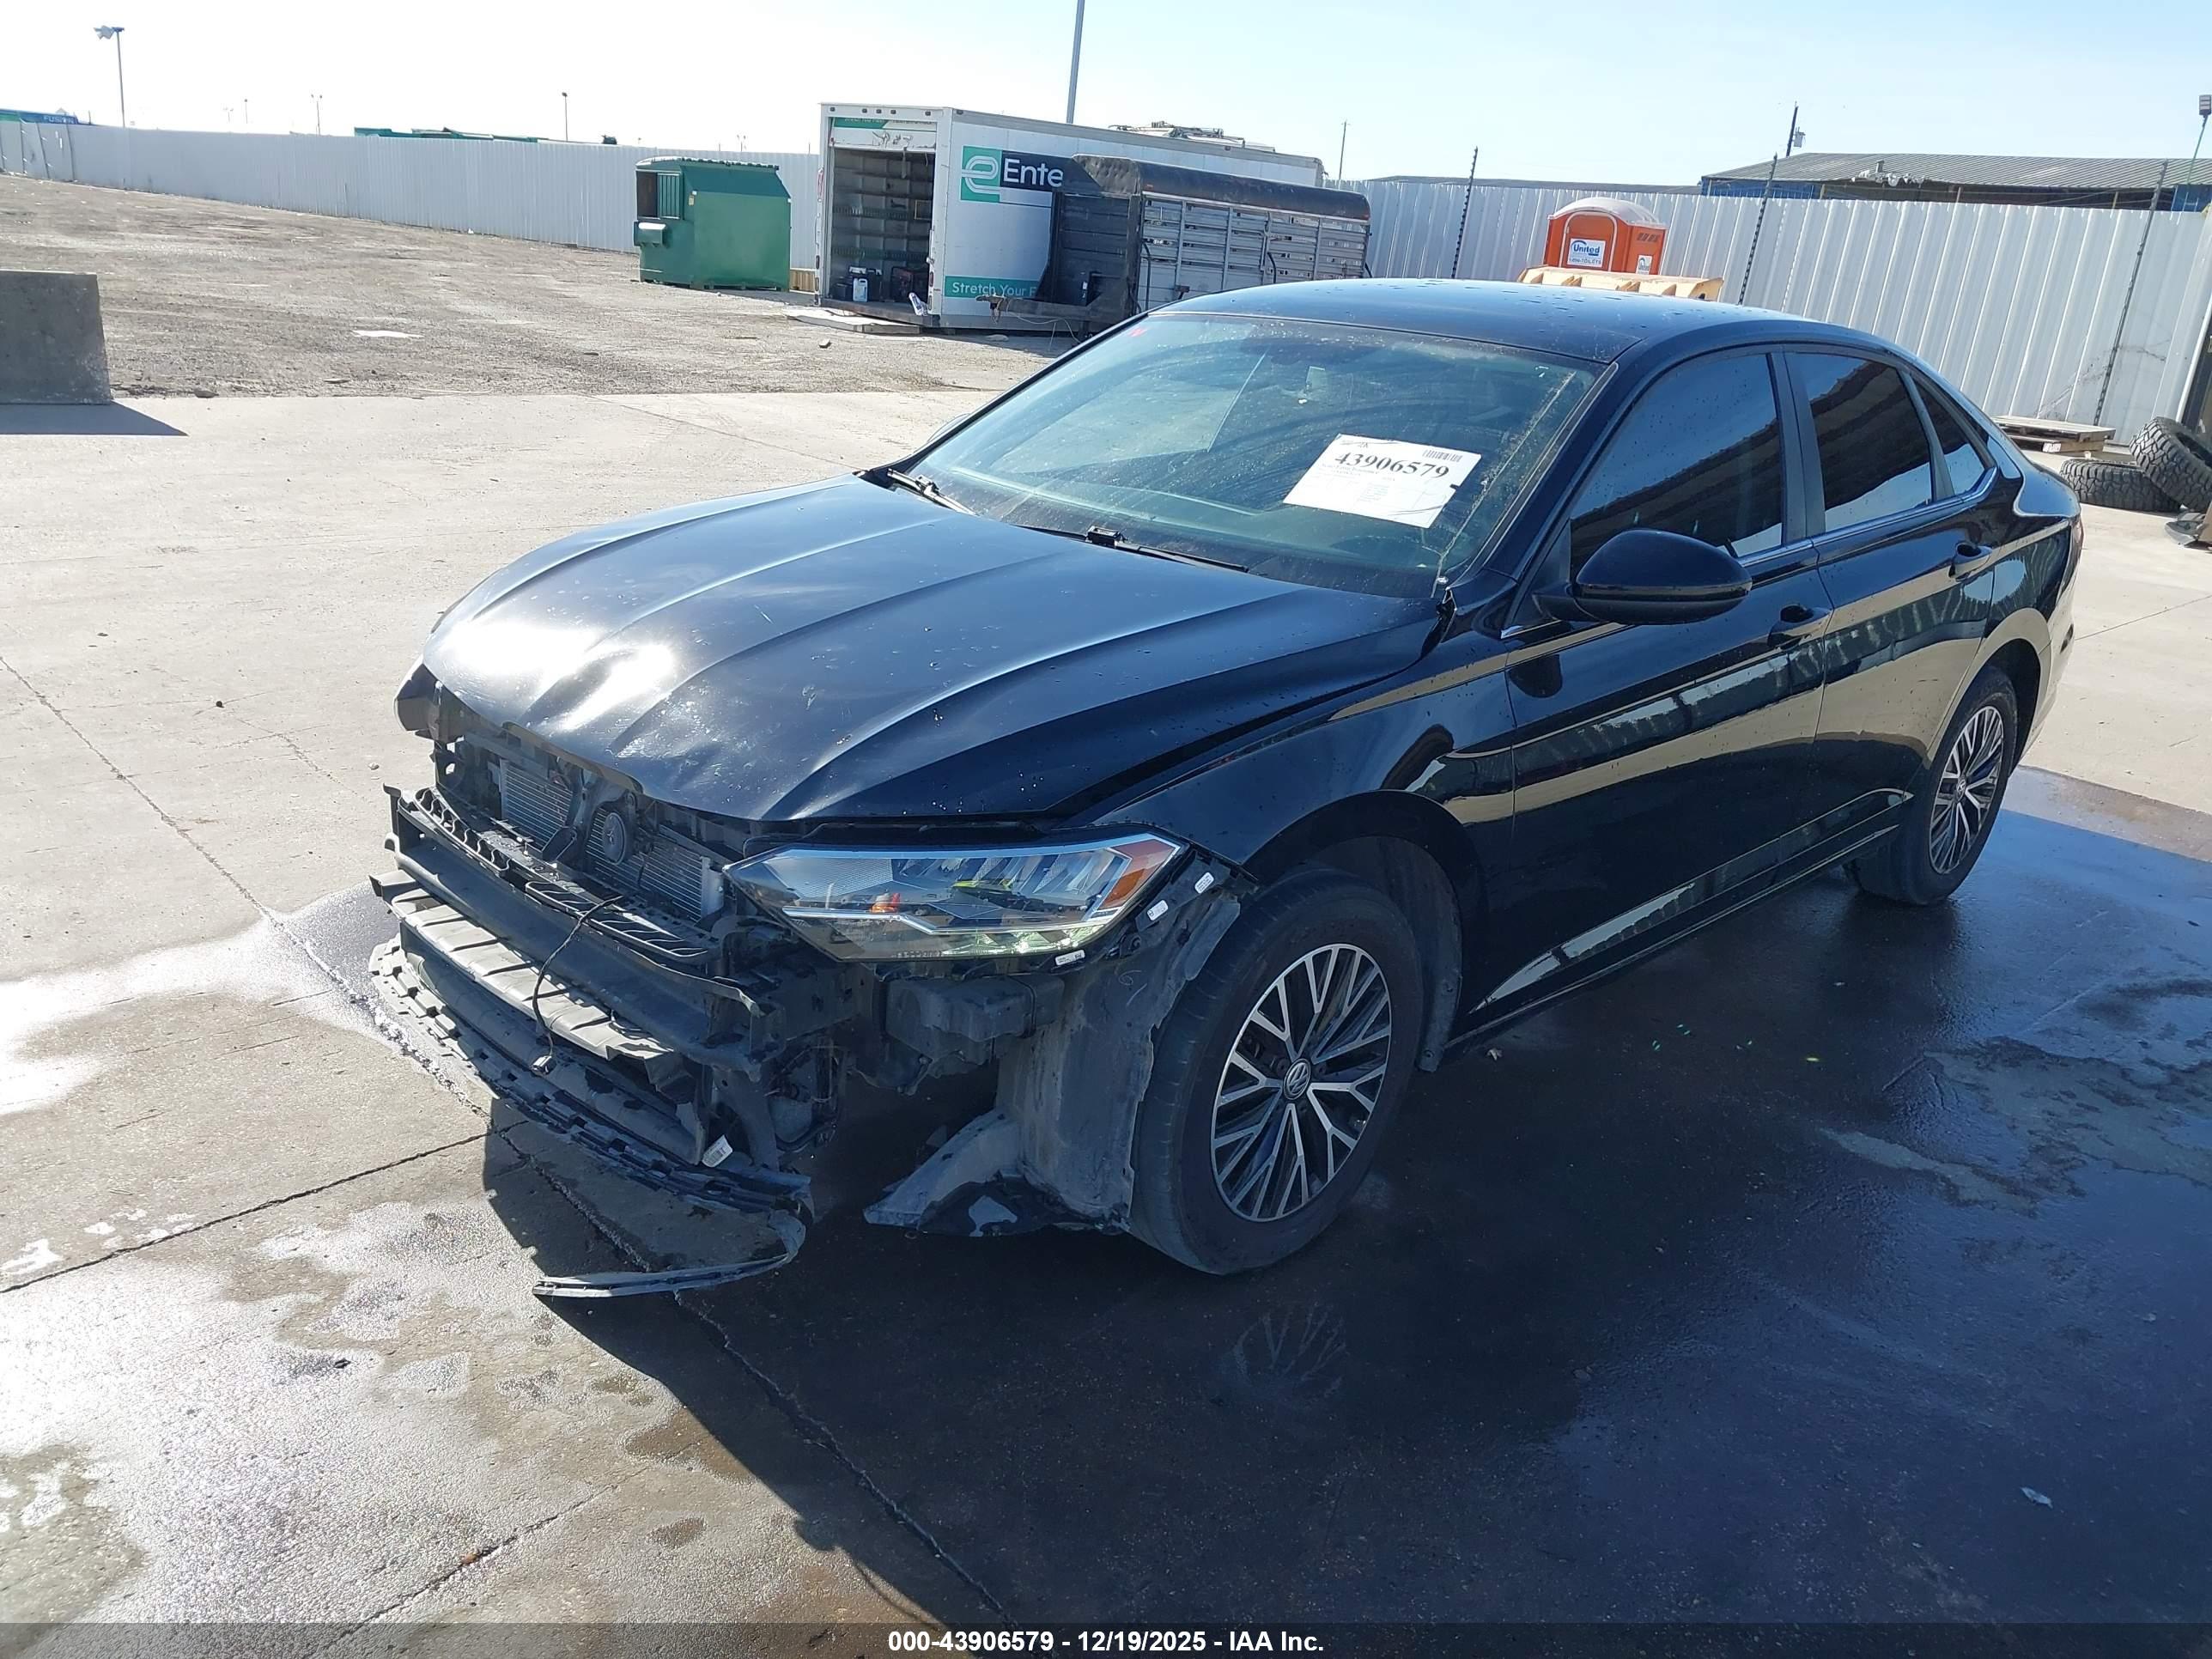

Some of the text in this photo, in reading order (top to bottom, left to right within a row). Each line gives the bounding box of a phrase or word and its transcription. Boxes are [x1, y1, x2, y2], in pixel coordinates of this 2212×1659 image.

[1003, 157, 1064, 187] Ente
[1573, 244, 1601, 254] United
[952, 282, 996, 295] Stretch
[1000, 284, 1027, 296] Your
[1334, 452, 1449, 478] 43906579
